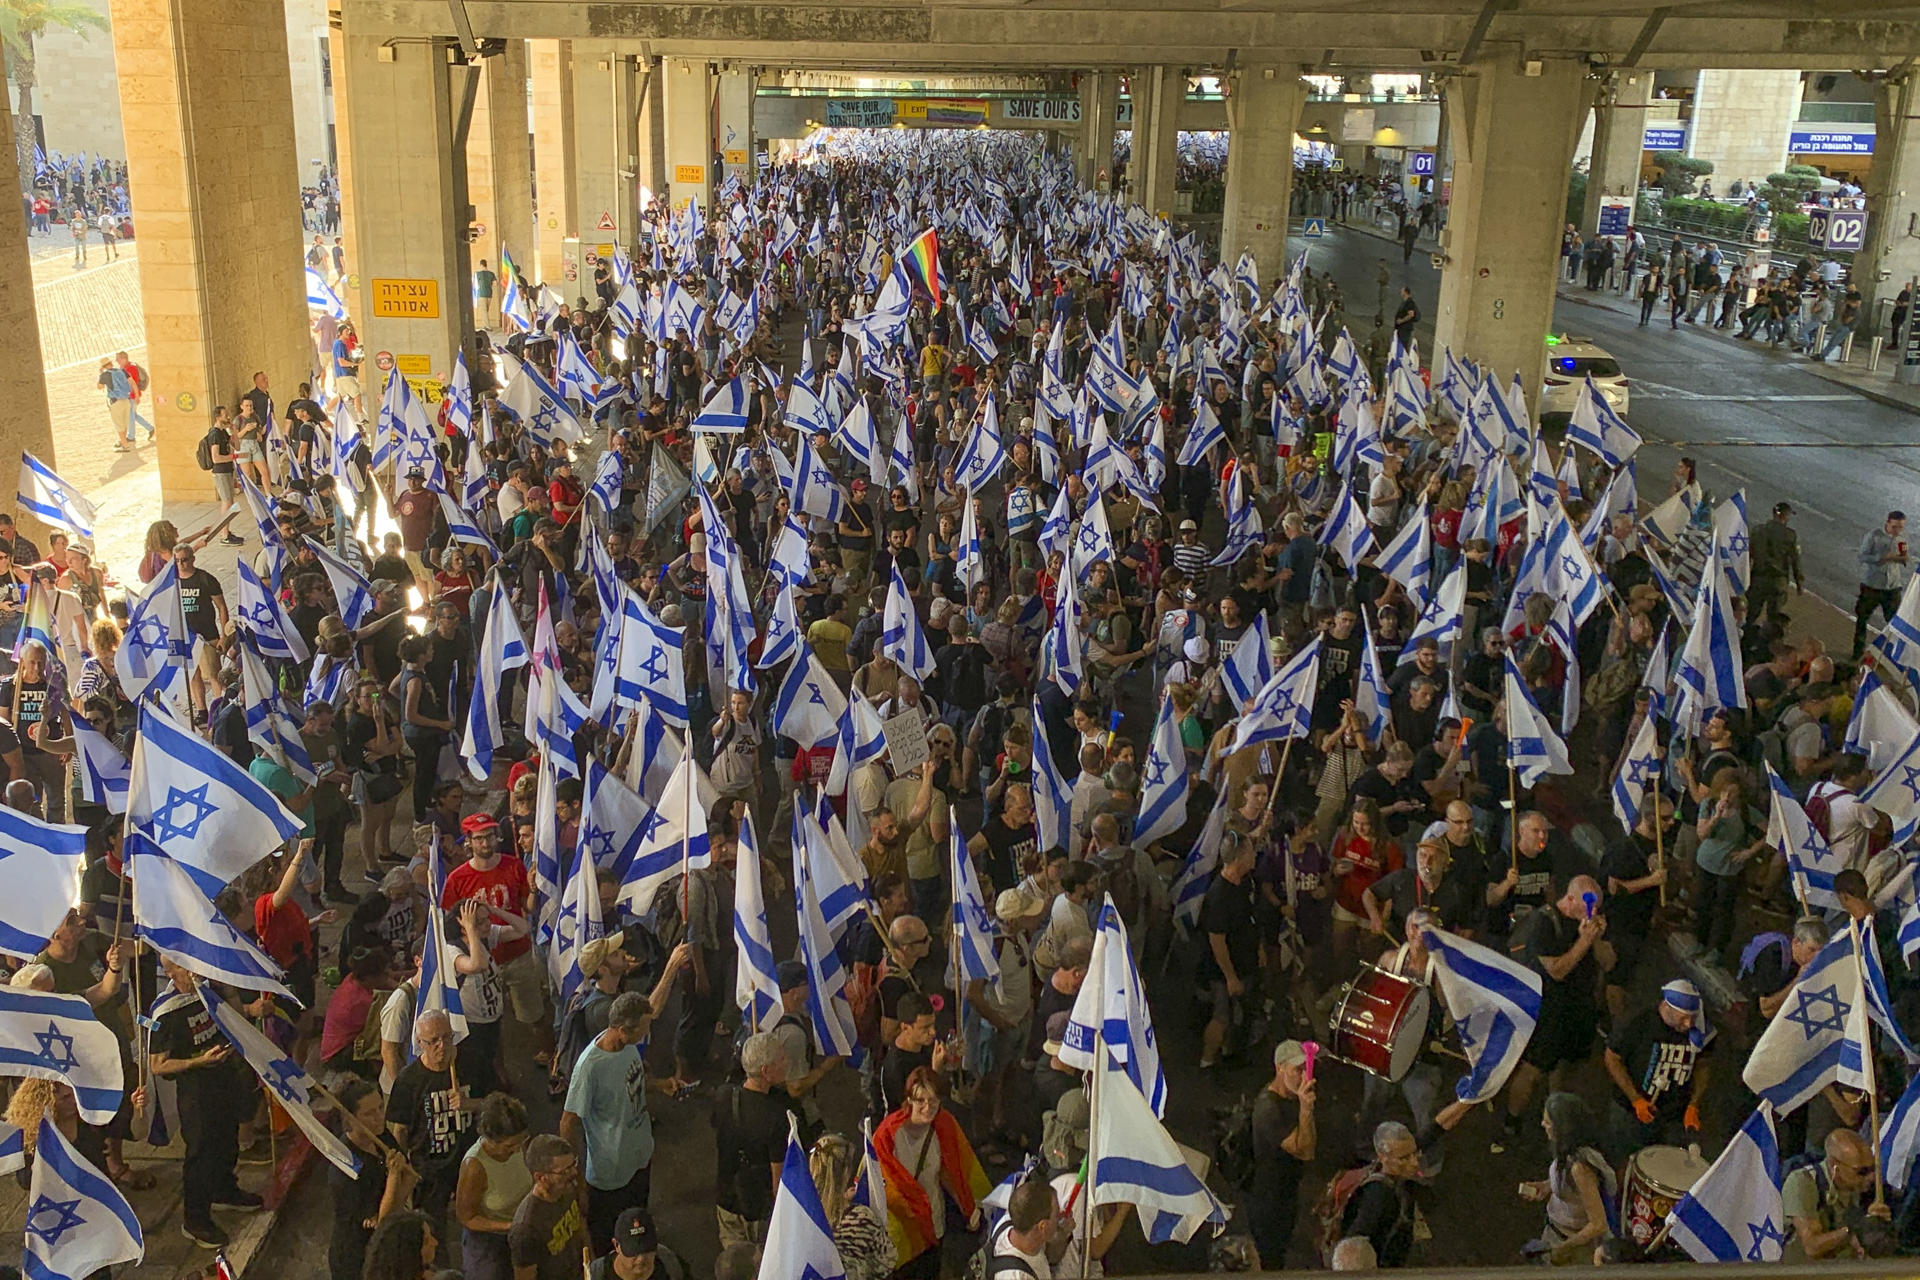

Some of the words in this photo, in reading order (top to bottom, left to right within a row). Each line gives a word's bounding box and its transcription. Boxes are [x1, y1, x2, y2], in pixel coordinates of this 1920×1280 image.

[841, 101, 862, 114] SAVE
[863, 100, 879, 113] OUR
[1009, 99, 1040, 118] SAVE
[1043, 100, 1069, 119] OUR
[829, 114, 862, 127] STARTUP
[864, 111, 892, 126] NATION
[1810, 134, 1830, 142] רכבת
[1812, 143, 1821, 151] בן
[1416, 156, 1432, 171] 01
[1810, 217, 1826, 241] 02
[1831, 219, 1862, 243] 02
[382, 283, 427, 296] עצירה
[383, 300, 429, 312] אסורה
